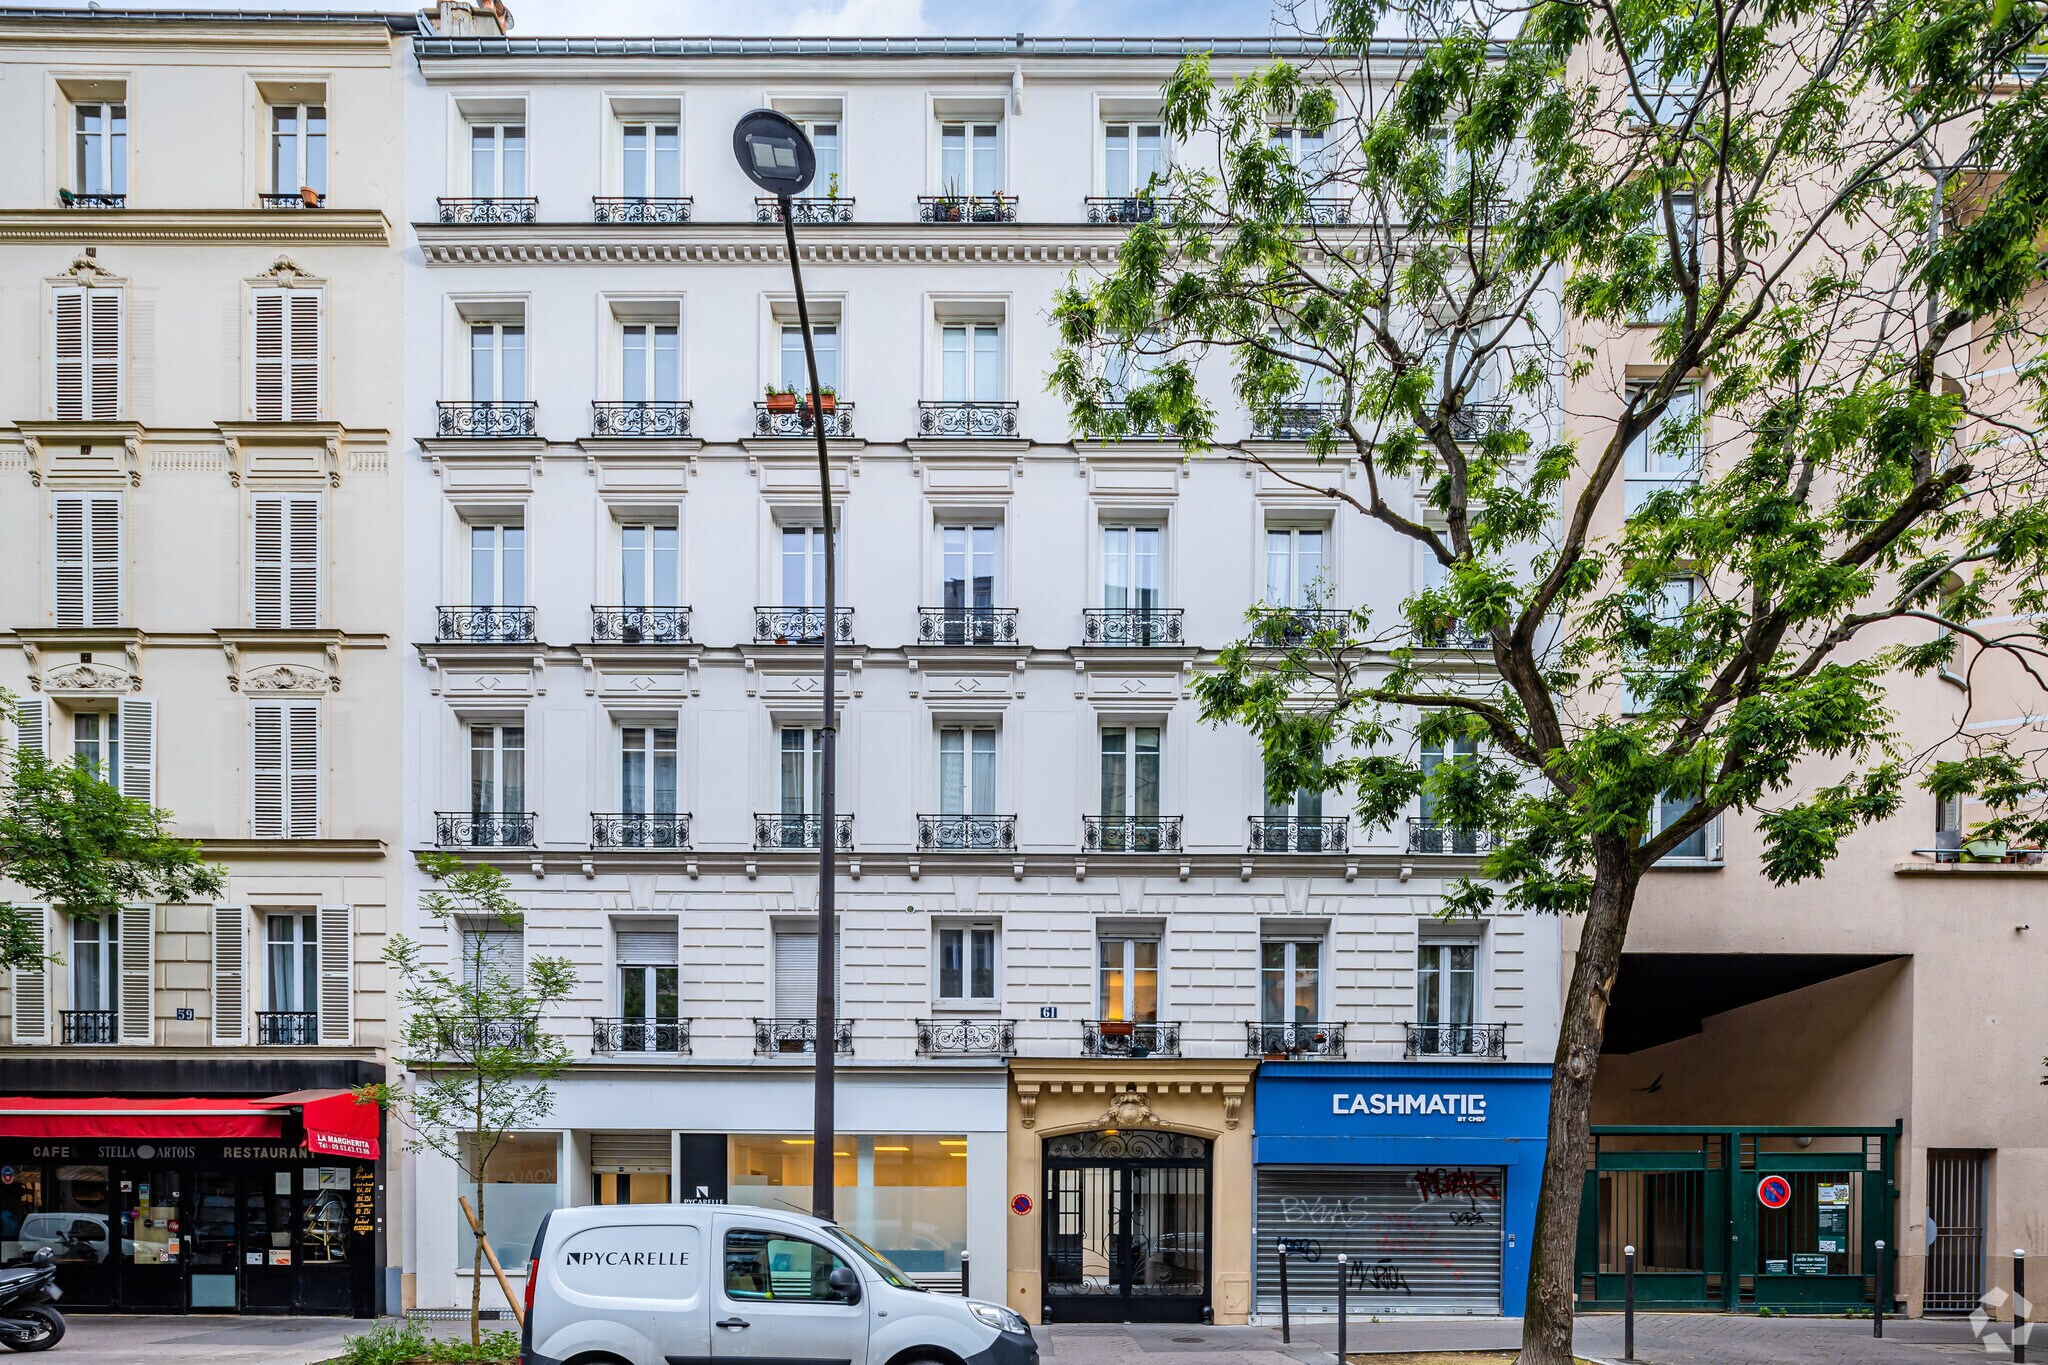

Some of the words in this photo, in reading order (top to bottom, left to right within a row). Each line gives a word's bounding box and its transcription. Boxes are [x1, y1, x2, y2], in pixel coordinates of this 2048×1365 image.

[178, 1009, 192, 1020] 59
[1043, 1007, 1055, 1018] 61
[1333, 1094, 1486, 1115] CASHMATIC
[317, 1134, 326, 1142] LA
[327, 1135, 370, 1149] MARGHERITA
[32, 1146, 70, 1158] CAFE
[98, 1145, 136, 1158] STELLA
[156, 1145, 195, 1159] ARTOIS
[582, 1252, 690, 1266] PYCARELLE
